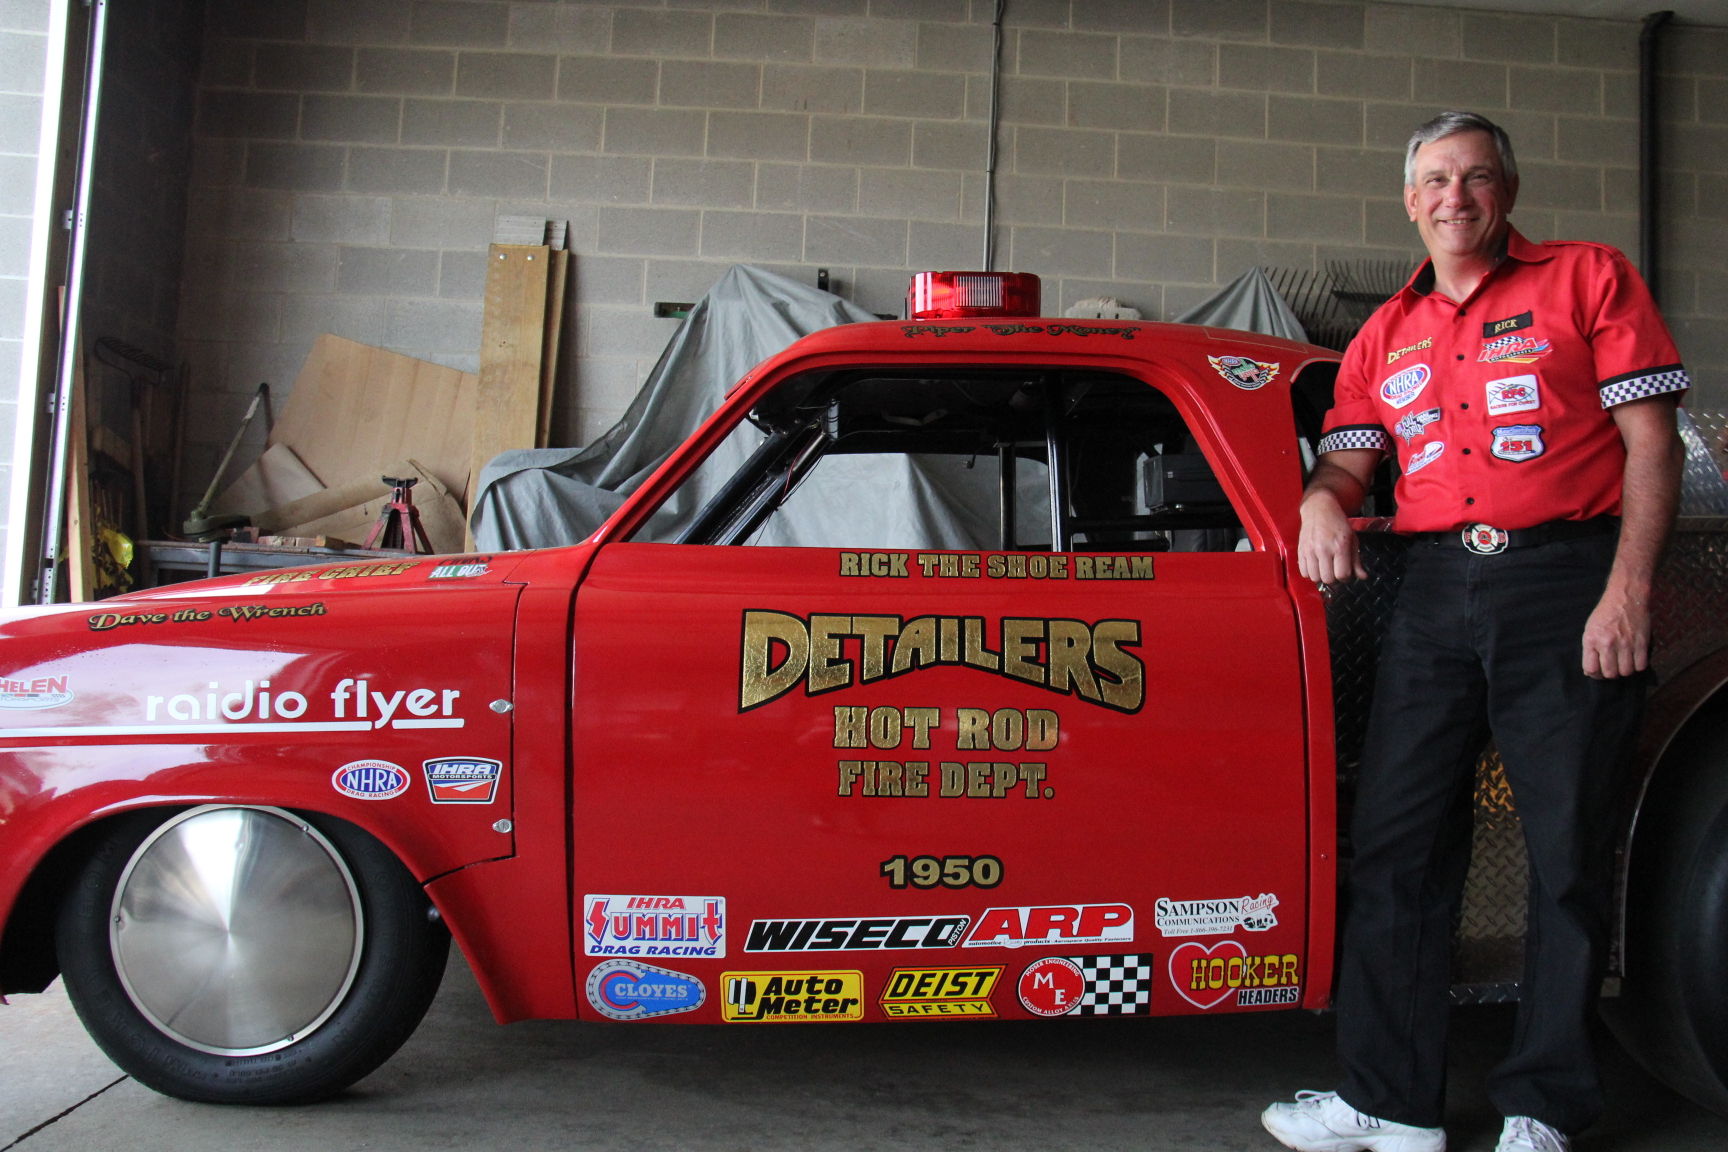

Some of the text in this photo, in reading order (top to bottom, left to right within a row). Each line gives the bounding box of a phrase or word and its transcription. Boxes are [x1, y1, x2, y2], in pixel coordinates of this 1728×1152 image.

[1494, 319, 1518, 335] RICK
[1387, 336, 1432, 365] DETAILERS
[1476, 337, 1538, 362] IHRA
[1388, 371, 1420, 395] NHRA
[1502, 387, 1526, 399] RFC
[242, 562, 421, 587] FIRE CHIEF
[429, 565, 457, 578] ALL
[839, 552, 1155, 580] RICK THE SHOE REAM
[88, 602, 327, 632] Dave the Wrench
[738, 608, 1146, 715] DETAILERS
[146, 678, 460, 729] raidio flyer
[833, 705, 1060, 751] HOT ROD
[346, 762, 398, 772] CHAMPIONSHIP
[433, 763, 491, 775] IHRA
[347, 768, 398, 792] NHRA
[838, 760, 1055, 799] FIRE DEPT.
[345, 788, 366, 798] DRAG
[880, 854, 1004, 889] 1950
[626, 897, 686, 911] IHRA
[1156, 895, 1275, 917] SAMPSON Racing
[947, 918, 967, 946] PISTON
[968, 905, 1132, 941] ARP
[1157, 915, 1240, 927] COMMUNICATIONS
[1176, 927, 1188, 935] Free
[745, 918, 970, 951] WISECO
[590, 945, 717, 956] DRAG RACING
[1025, 959, 1080, 977] MOSER ENGINEERING
[1190, 953, 1299, 990] HOOKER
[614, 983, 688, 998] CLOYES
[762, 976, 843, 996] Auto
[888, 971, 996, 998] DEIST
[1033, 972, 1067, 1005] M E
[1238, 986, 1298, 1006] HEADERS
[757, 996, 859, 1015] Meter
[888, 1004, 984, 1014] SAFETY
[1022, 996, 1043, 1014] CUSTOM
